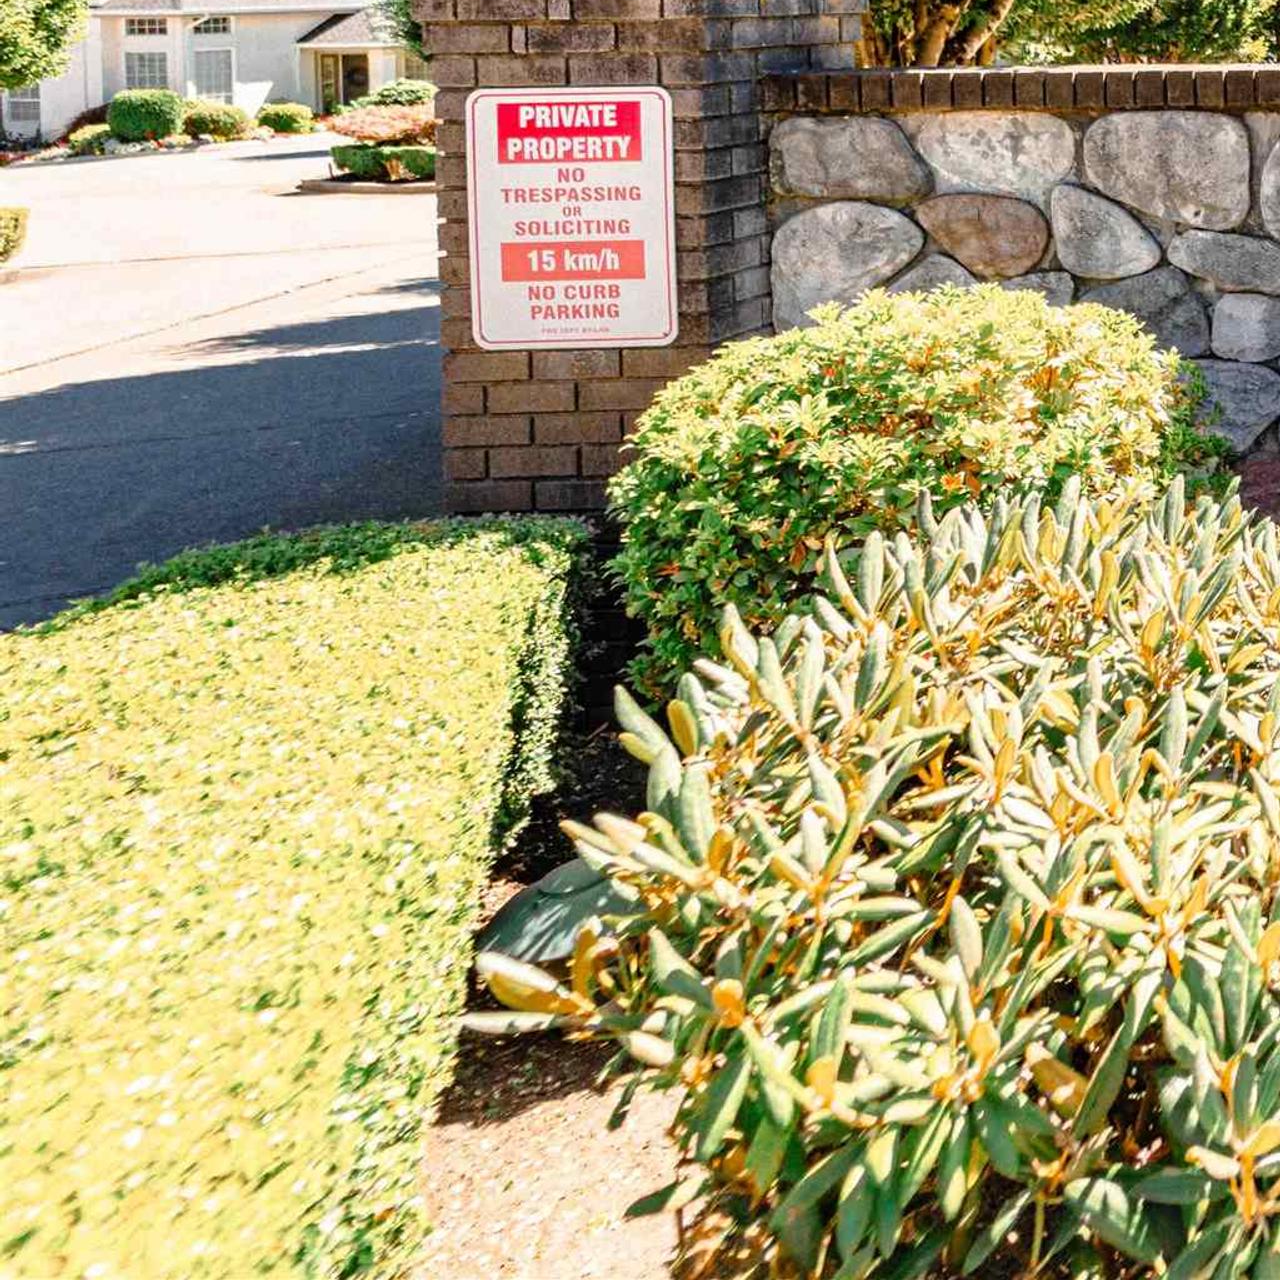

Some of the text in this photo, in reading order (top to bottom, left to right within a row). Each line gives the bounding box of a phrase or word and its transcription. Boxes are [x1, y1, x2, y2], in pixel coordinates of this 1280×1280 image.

[519, 105, 617, 128] PRIVATE
[507, 136, 631, 160] PROPERTY
[557, 168, 585, 183] NO
[501, 186, 641, 203] TRESPASSING
[563, 206, 582, 217] OR
[515, 220, 630, 236] SOLICITING
[528, 248, 620, 271] 15 km/h
[528, 285, 621, 300] NO CURB
[531, 303, 620, 320] PARKING
